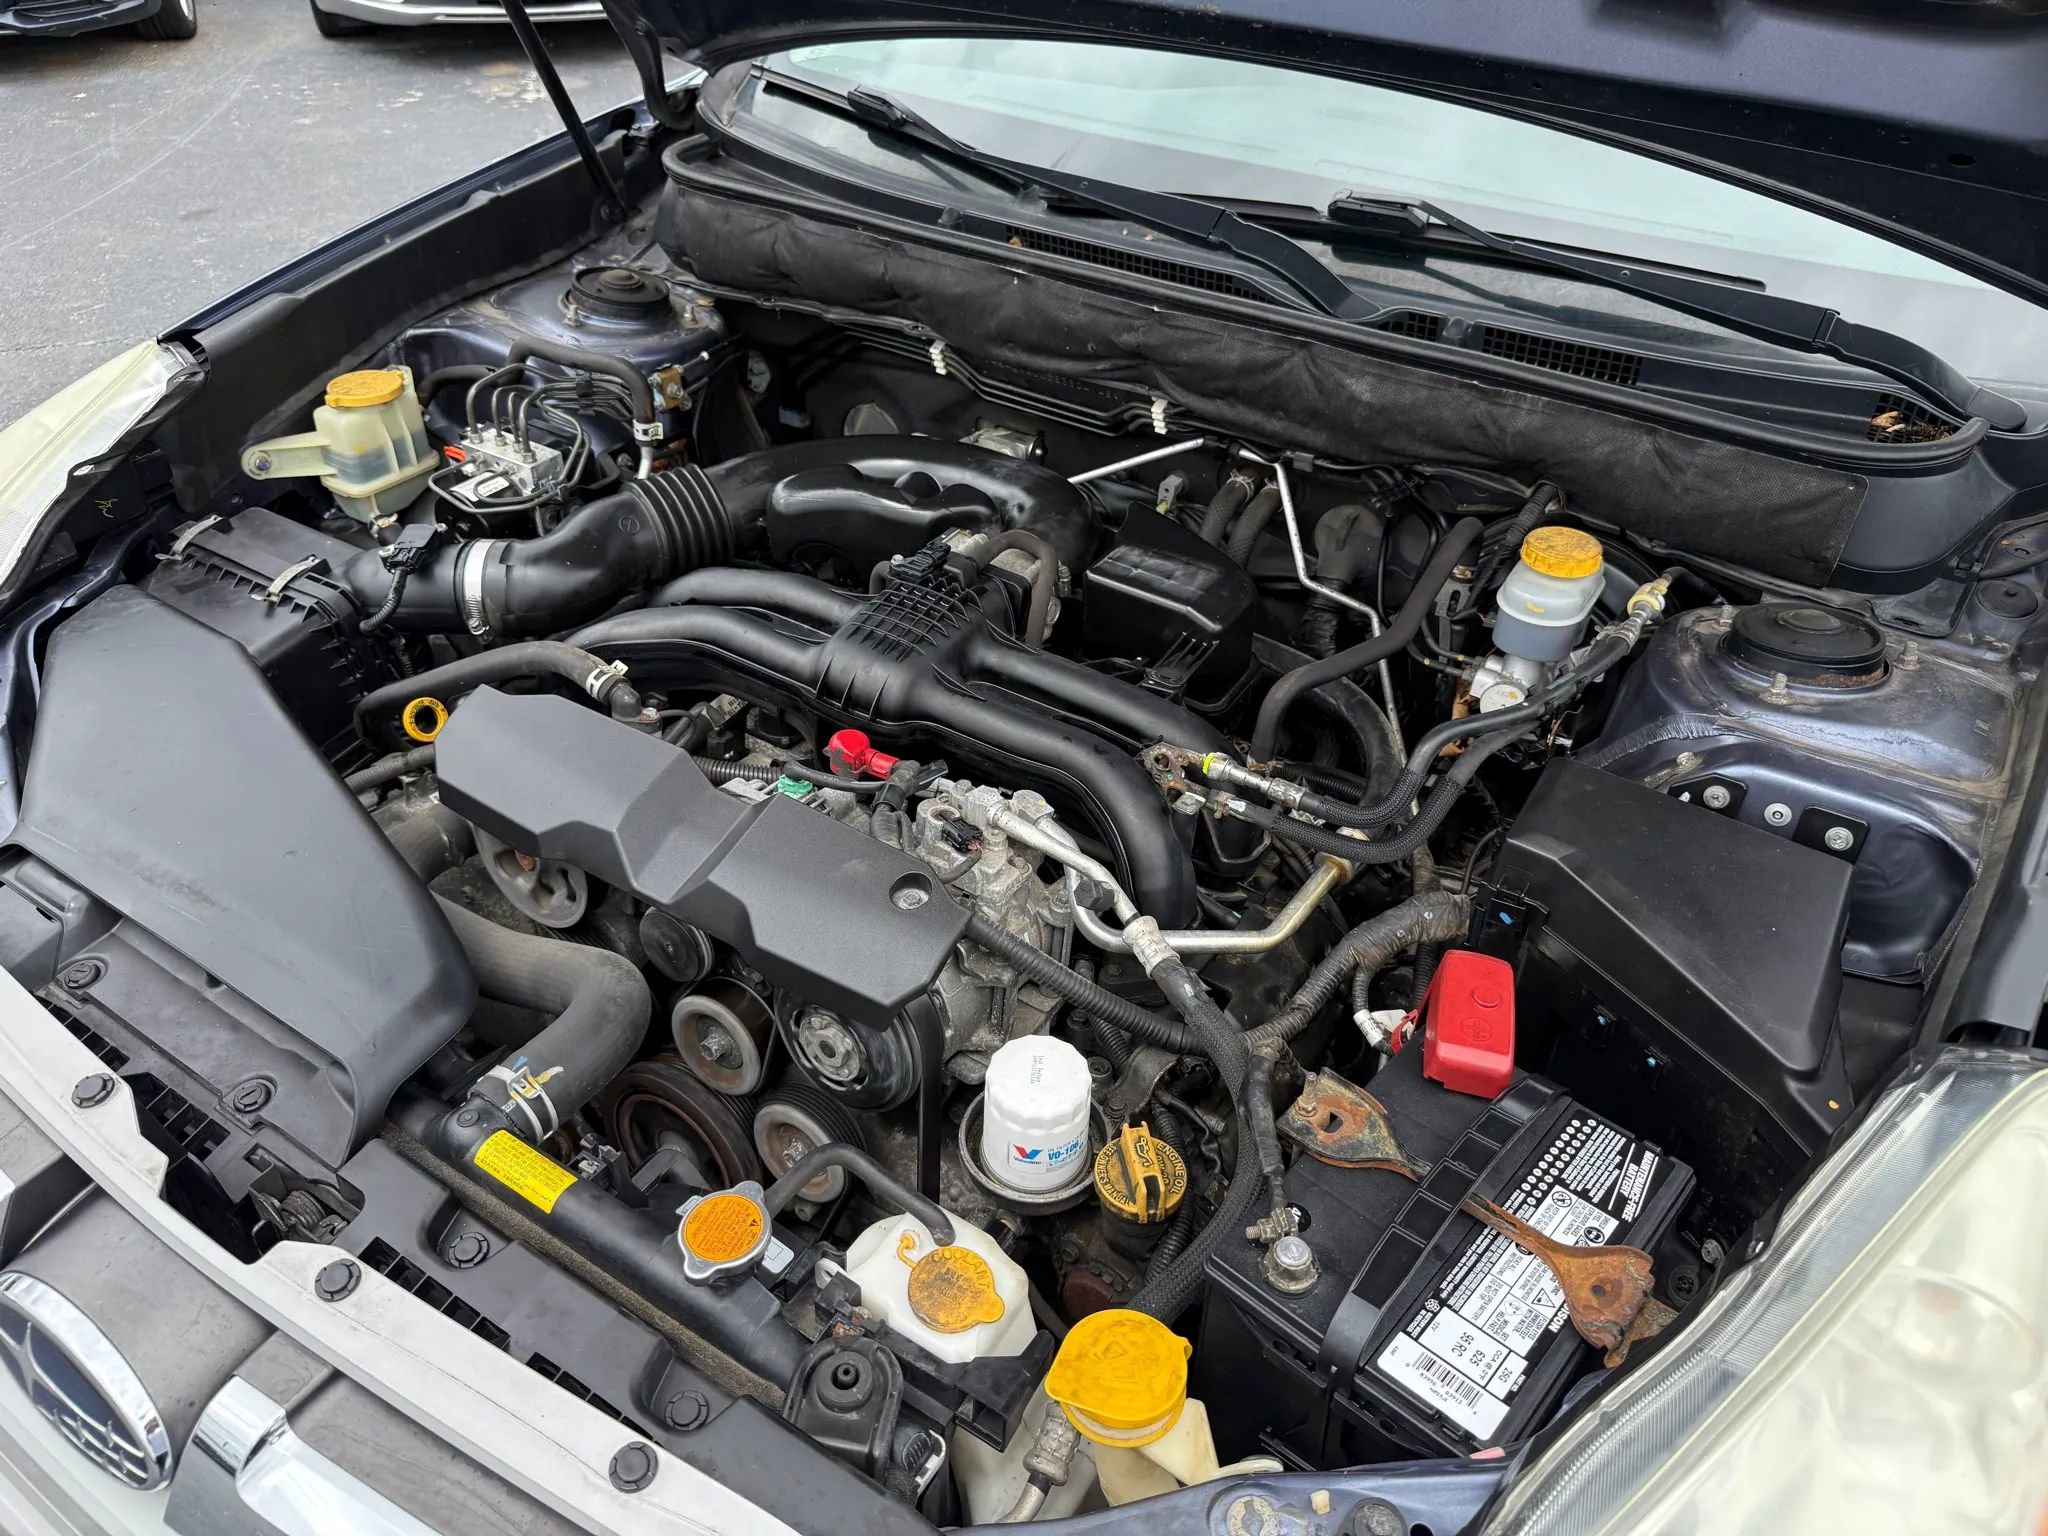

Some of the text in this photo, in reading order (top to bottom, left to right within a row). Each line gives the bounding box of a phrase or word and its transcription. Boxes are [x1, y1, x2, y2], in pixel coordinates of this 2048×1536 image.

[1047, 1139, 1081, 1161] VO-106
[1105, 1143, 1117, 1156] SEE
[1157, 1142, 1185, 1194] ENGINE OIL
[1619, 1162, 1638, 1197] BATTERY
[1621, 1150, 1654, 1222] MAINTENANCE-FREE
[1103, 1184, 1130, 1206] MANUAL
[931, 1248, 991, 1289] COOLANT
[1429, 1320, 1441, 1332] 12V
[1449, 1331, 1474, 1357] 95 RC
[1468, 1348, 1486, 1367] 625
[1489, 1348, 1503, 1364] CCA
[1497, 1366, 1513, 1384] 25G
